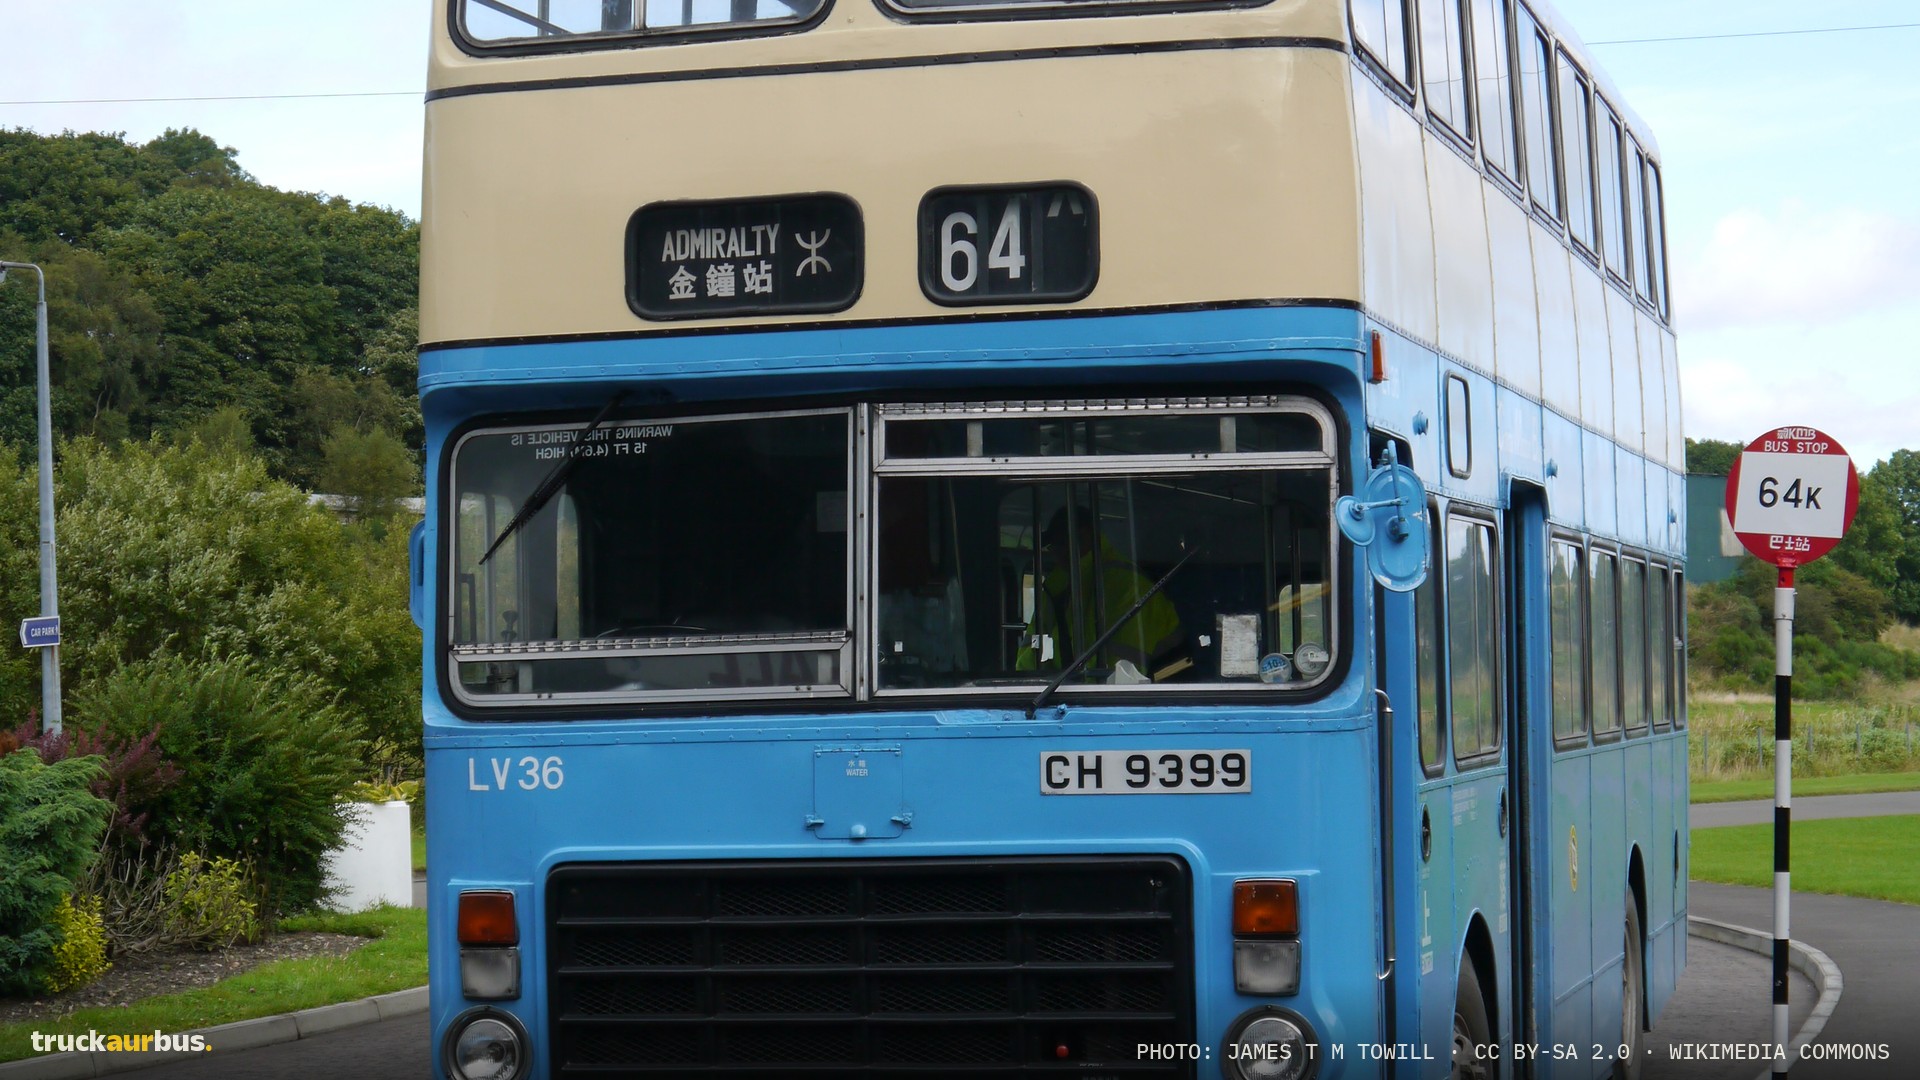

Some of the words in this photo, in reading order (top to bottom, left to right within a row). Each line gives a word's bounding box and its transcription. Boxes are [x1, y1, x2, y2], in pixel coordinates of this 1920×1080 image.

[661, 223, 780, 262] ADMIRALTY
[668, 262, 773, 300] 金鐘站
[1764, 440, 1789, 452] BUS
[1796, 441, 1829, 454] STOP
[1759, 476, 1822, 510] 64K
[1769, 535, 1811, 551] 巴士站
[31, 628, 41, 637] CAR
[42, 627, 54, 636] PARK
[1045, 755, 1103, 789] CH
[1125, 753, 1246, 788] 9399
